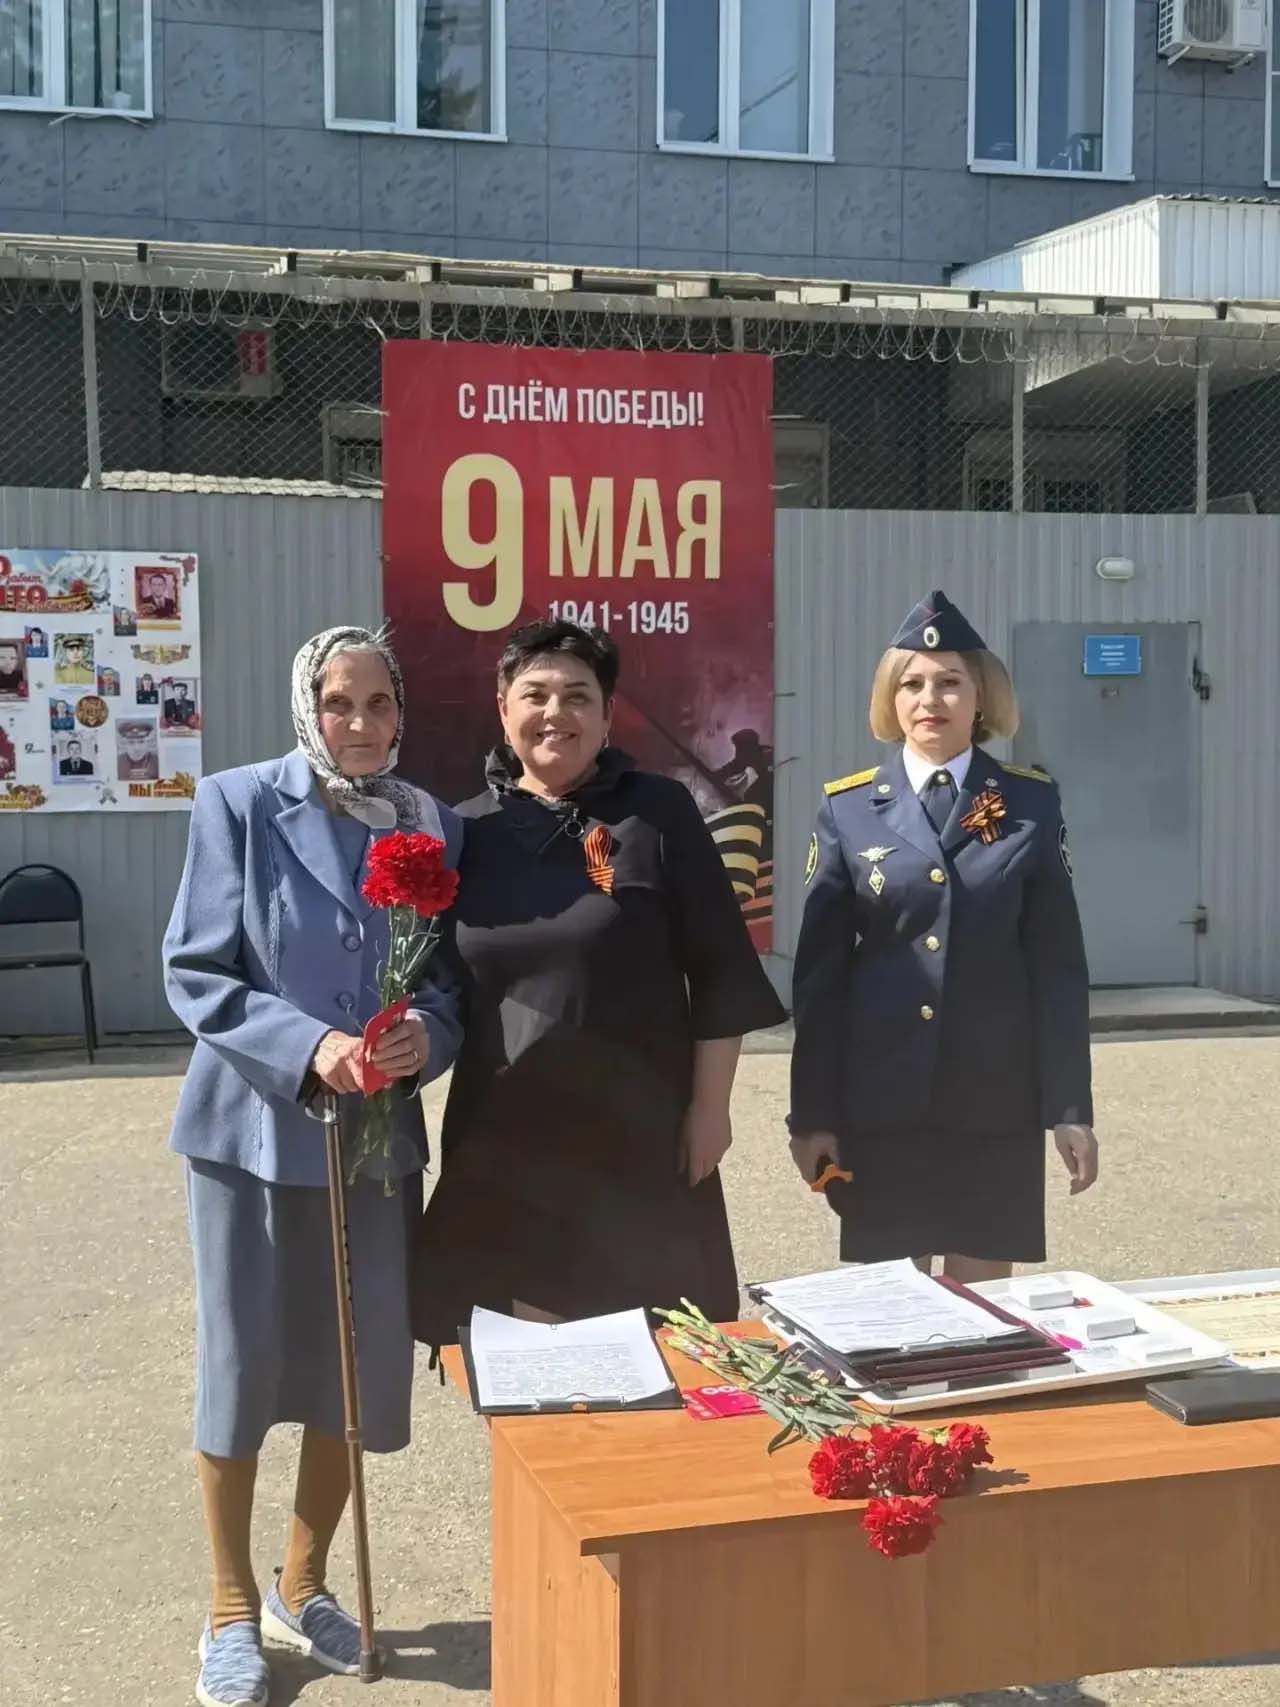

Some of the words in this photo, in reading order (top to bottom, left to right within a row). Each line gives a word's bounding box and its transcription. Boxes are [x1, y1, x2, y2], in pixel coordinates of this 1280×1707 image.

[458, 382, 477, 419] С
[483, 379, 569, 424] ДНЁМ
[576, 388, 705, 429] ПОБЕДЫ!
[442, 453, 524, 632] 9
[549, 476, 721, 579] МАЯ
[548, 600, 690, 635] 1941-1945
